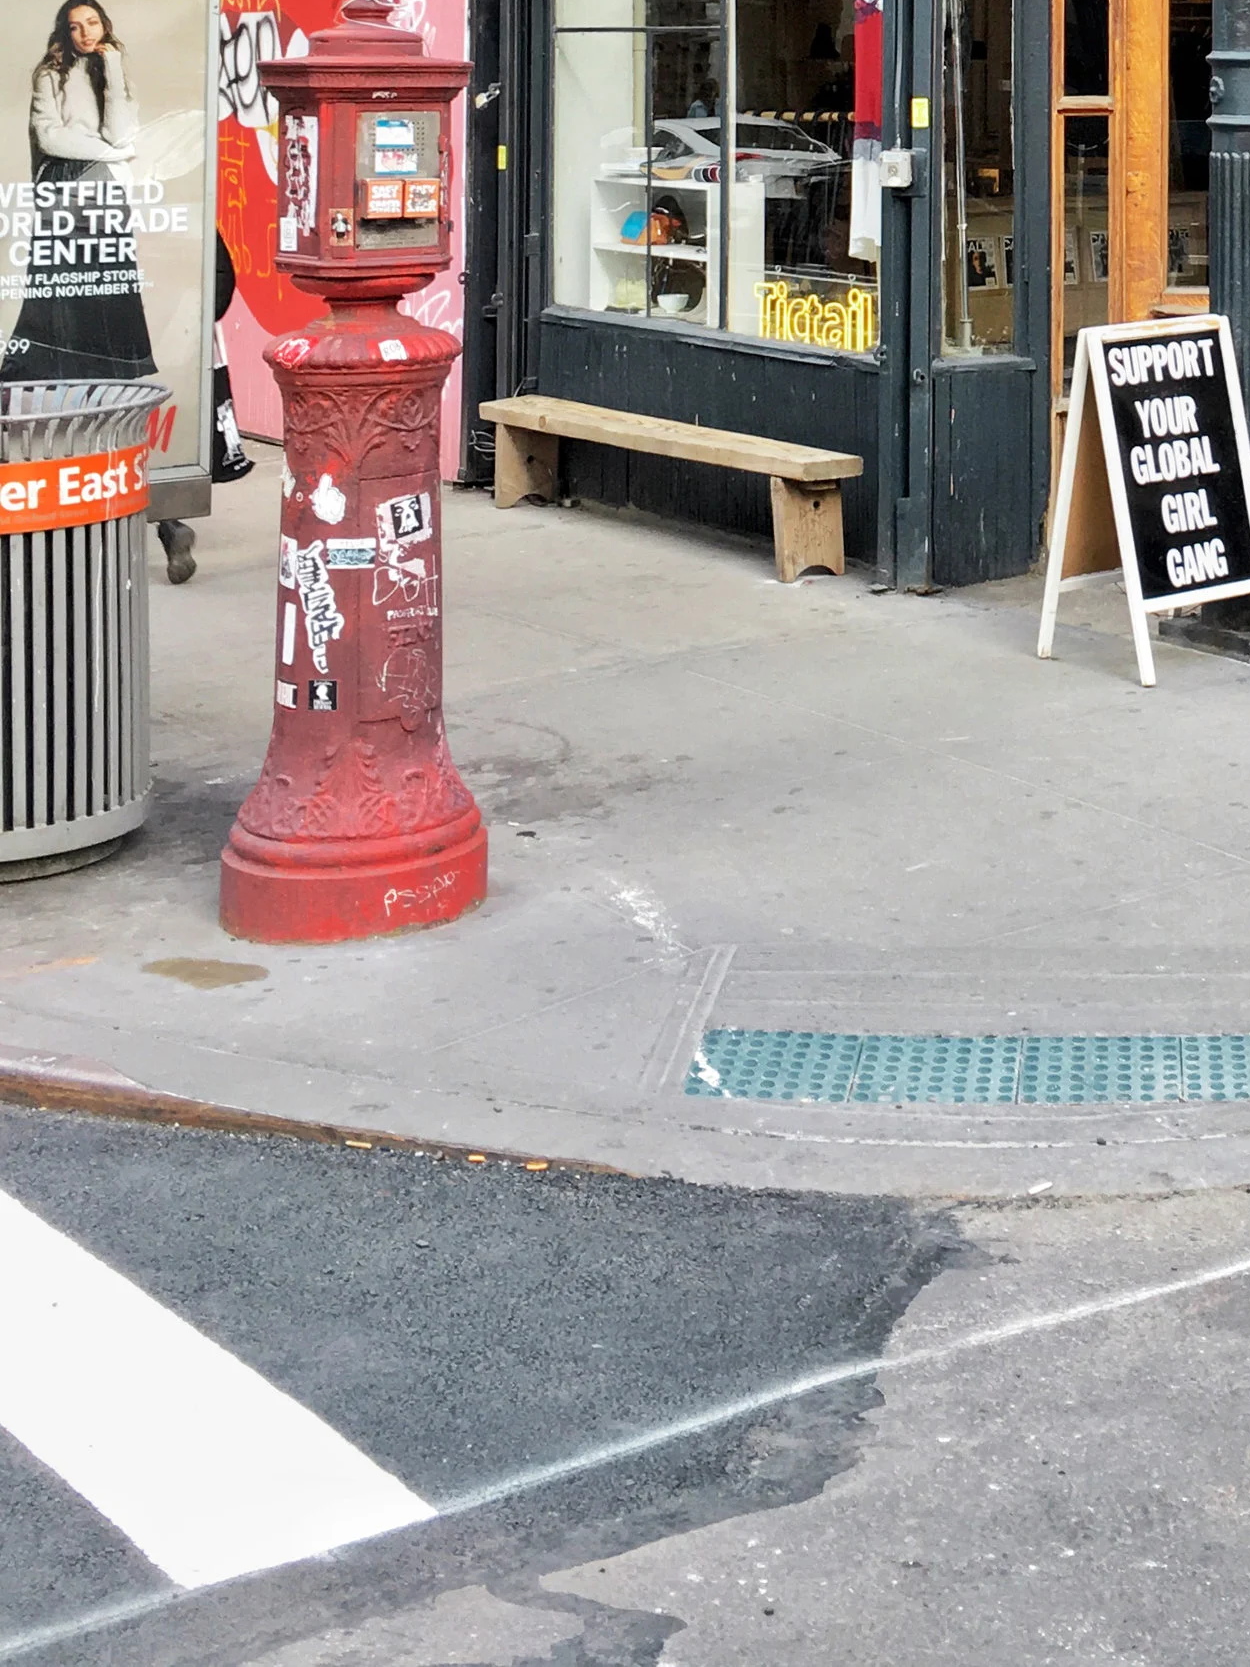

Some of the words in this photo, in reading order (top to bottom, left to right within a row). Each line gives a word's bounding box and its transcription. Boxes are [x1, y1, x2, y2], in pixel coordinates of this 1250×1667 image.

[82, 206, 189, 235] TRADE
[9, 237, 138, 267] CENTER
[0, 274, 33, 287] NEW
[35, 271, 101, 285] FLAGSHIP
[103, 269, 145, 282] STORE
[0, 286, 53, 300] PENING
[56, 283, 130, 298] NOVEMBER
[754, 280, 874, 353] Tictail
[1108, 338, 1215, 386] SUPPORT
[1134, 395, 1199, 438] YOUR
[1130, 435, 1221, 486] GLOBAL
[0, 478, 47, 511] er
[59, 460, 129, 505] East
[1161, 488, 1218, 534] GIRL
[1166, 538, 1229, 588] GANG
